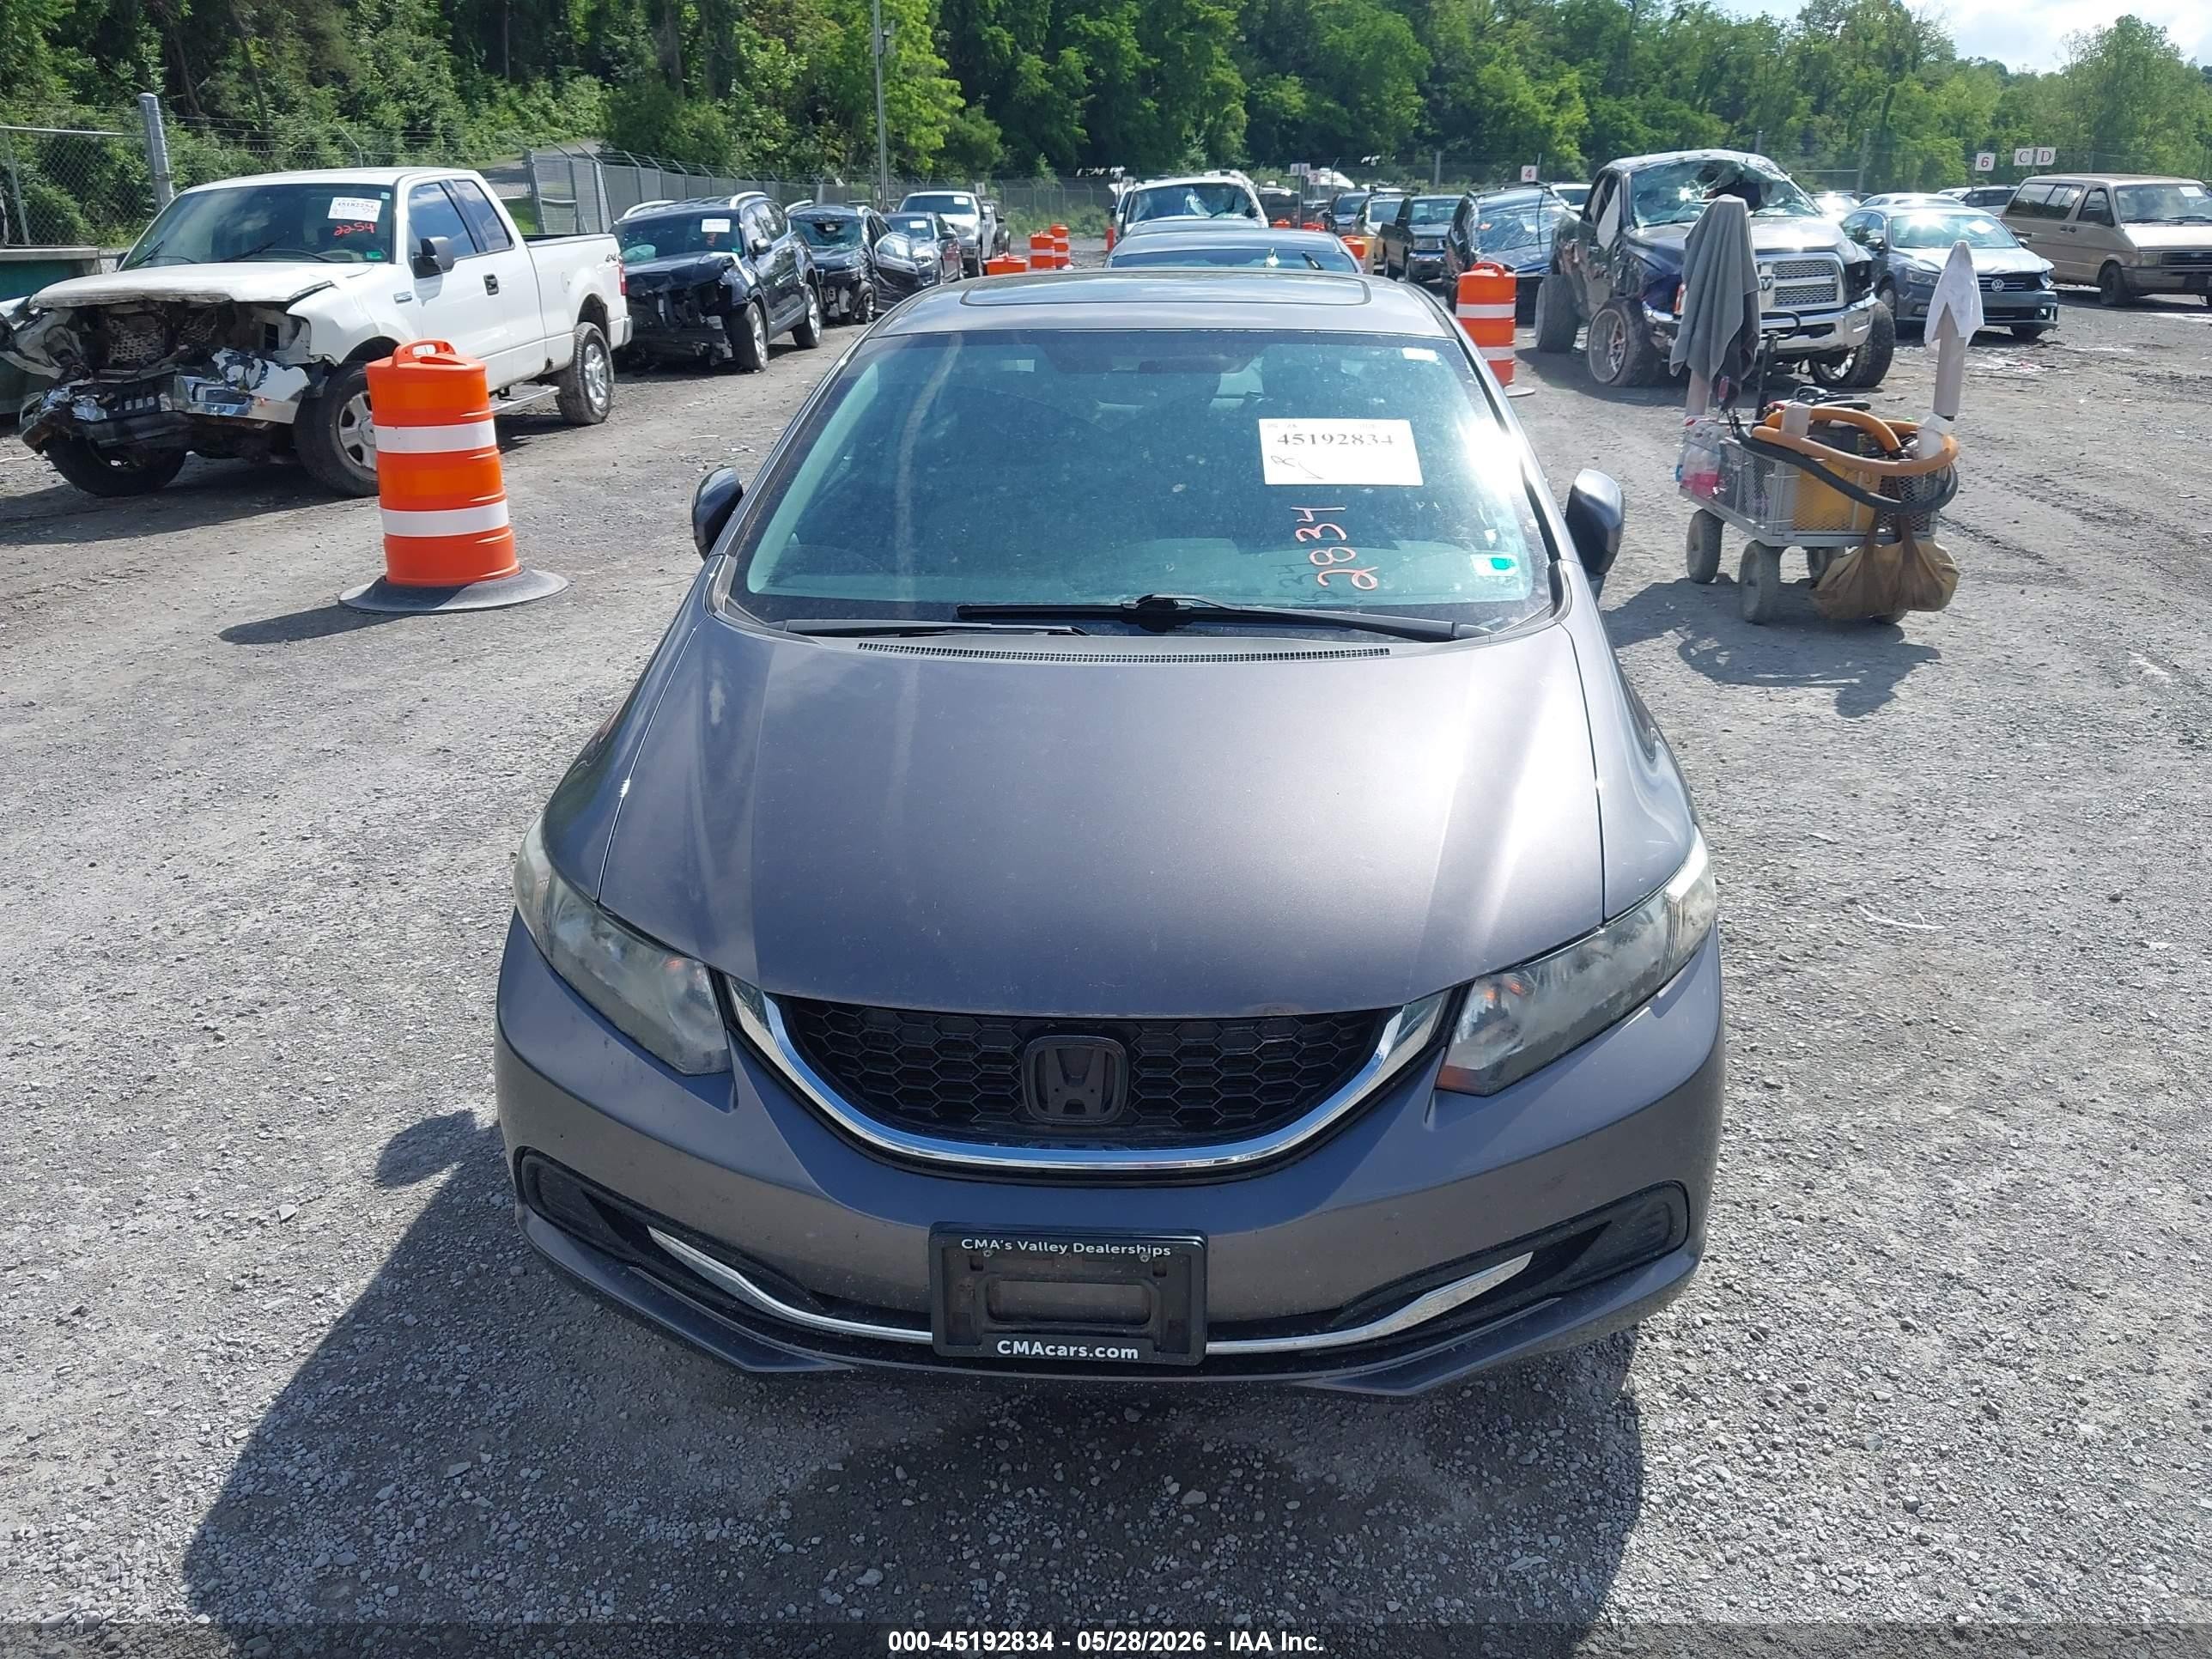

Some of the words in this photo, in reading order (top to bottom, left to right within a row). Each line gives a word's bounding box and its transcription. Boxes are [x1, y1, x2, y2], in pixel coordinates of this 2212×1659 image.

[1980, 156, 1990, 168] 6
[2018, 150, 2029, 163] C
[2039, 150, 2051, 163] D
[1311, 173, 1319, 183] 3
[1524, 168, 1533, 179] 4
[1276, 433, 1395, 446] 45192834
[1290, 505, 1378, 590] 2834
[961, 1238, 1012, 1250] CMA's
[1017, 1240, 1068, 1255] Valley
[1073, 1243, 1171, 1257] Dealerships
[996, 1340, 1139, 1359] CMAcars.com
